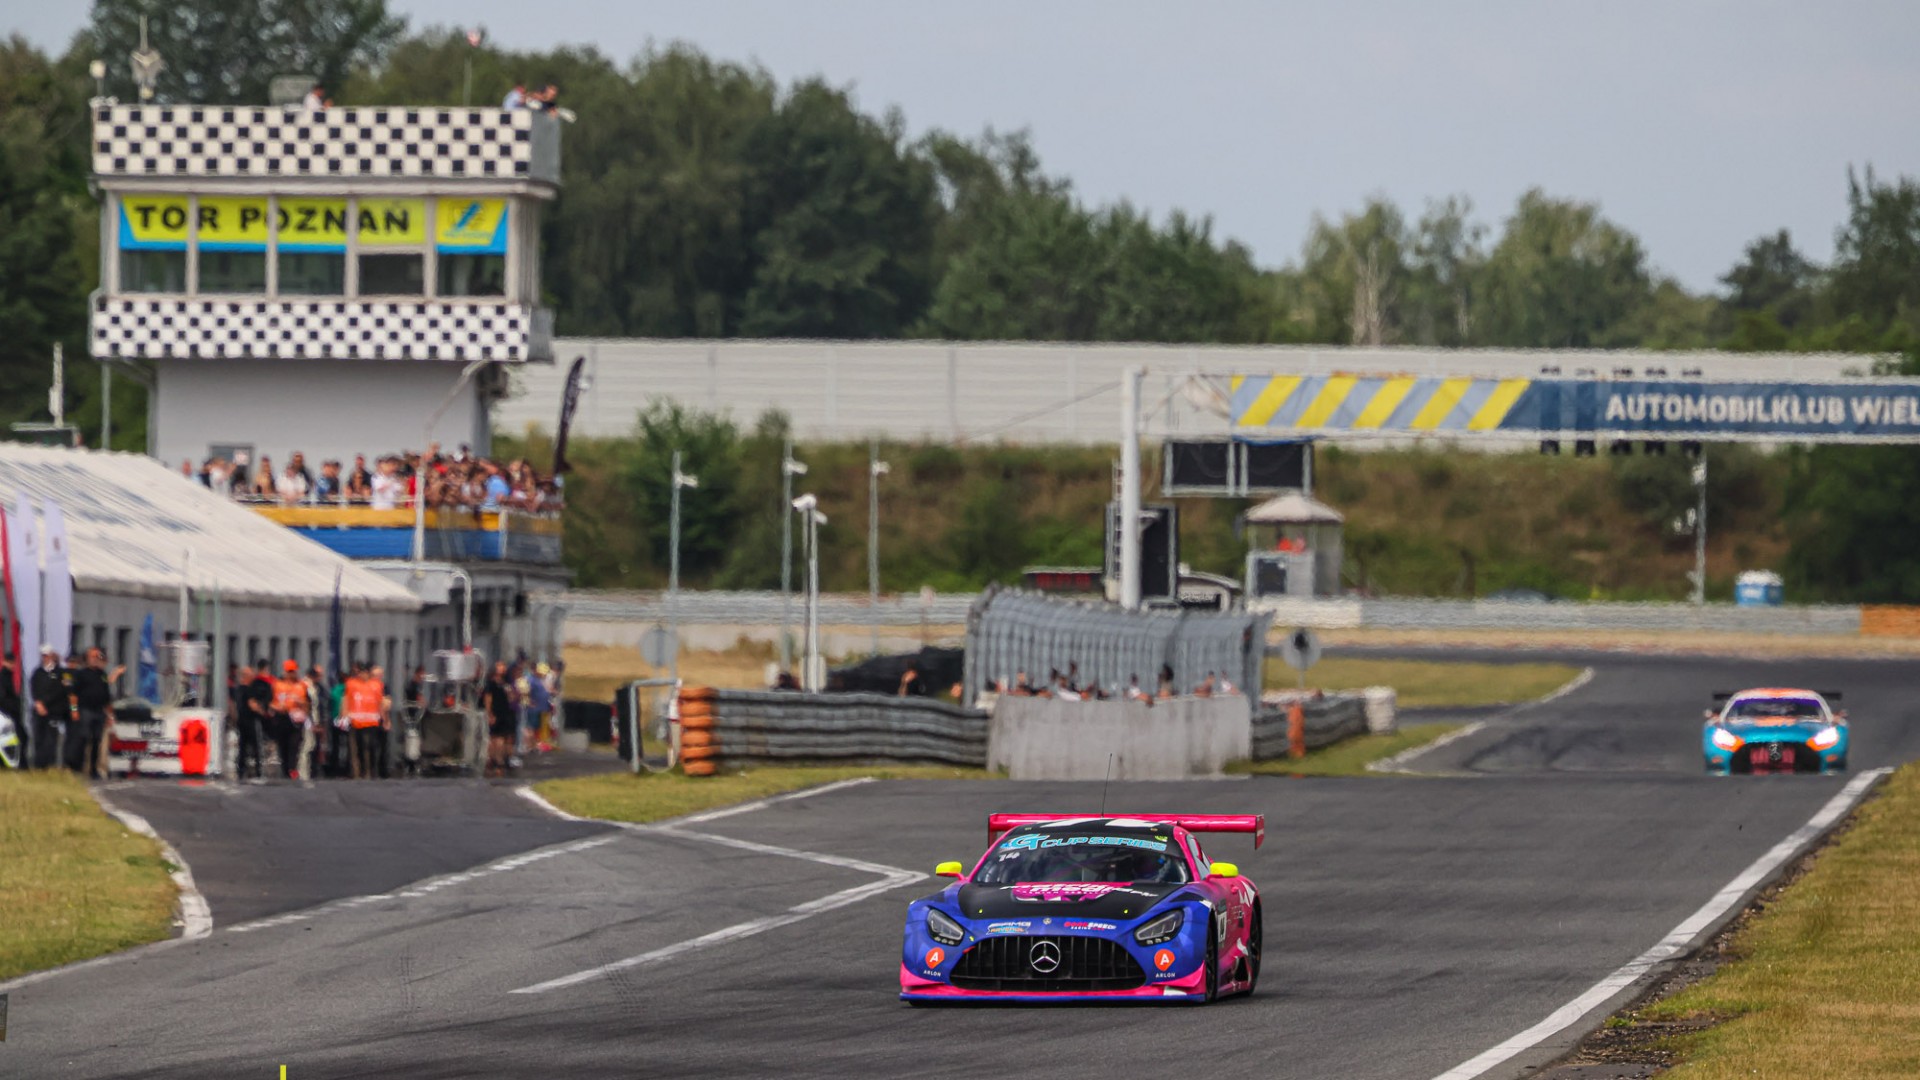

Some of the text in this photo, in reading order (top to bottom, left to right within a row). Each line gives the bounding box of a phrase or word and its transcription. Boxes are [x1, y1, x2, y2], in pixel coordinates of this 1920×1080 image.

[135, 204, 219, 232] TOR
[1605, 392, 1845, 424] AUTOMOBILKLUB
[1041, 836, 1088, 848] CUP
[1088, 836, 1167, 852] SERIES
